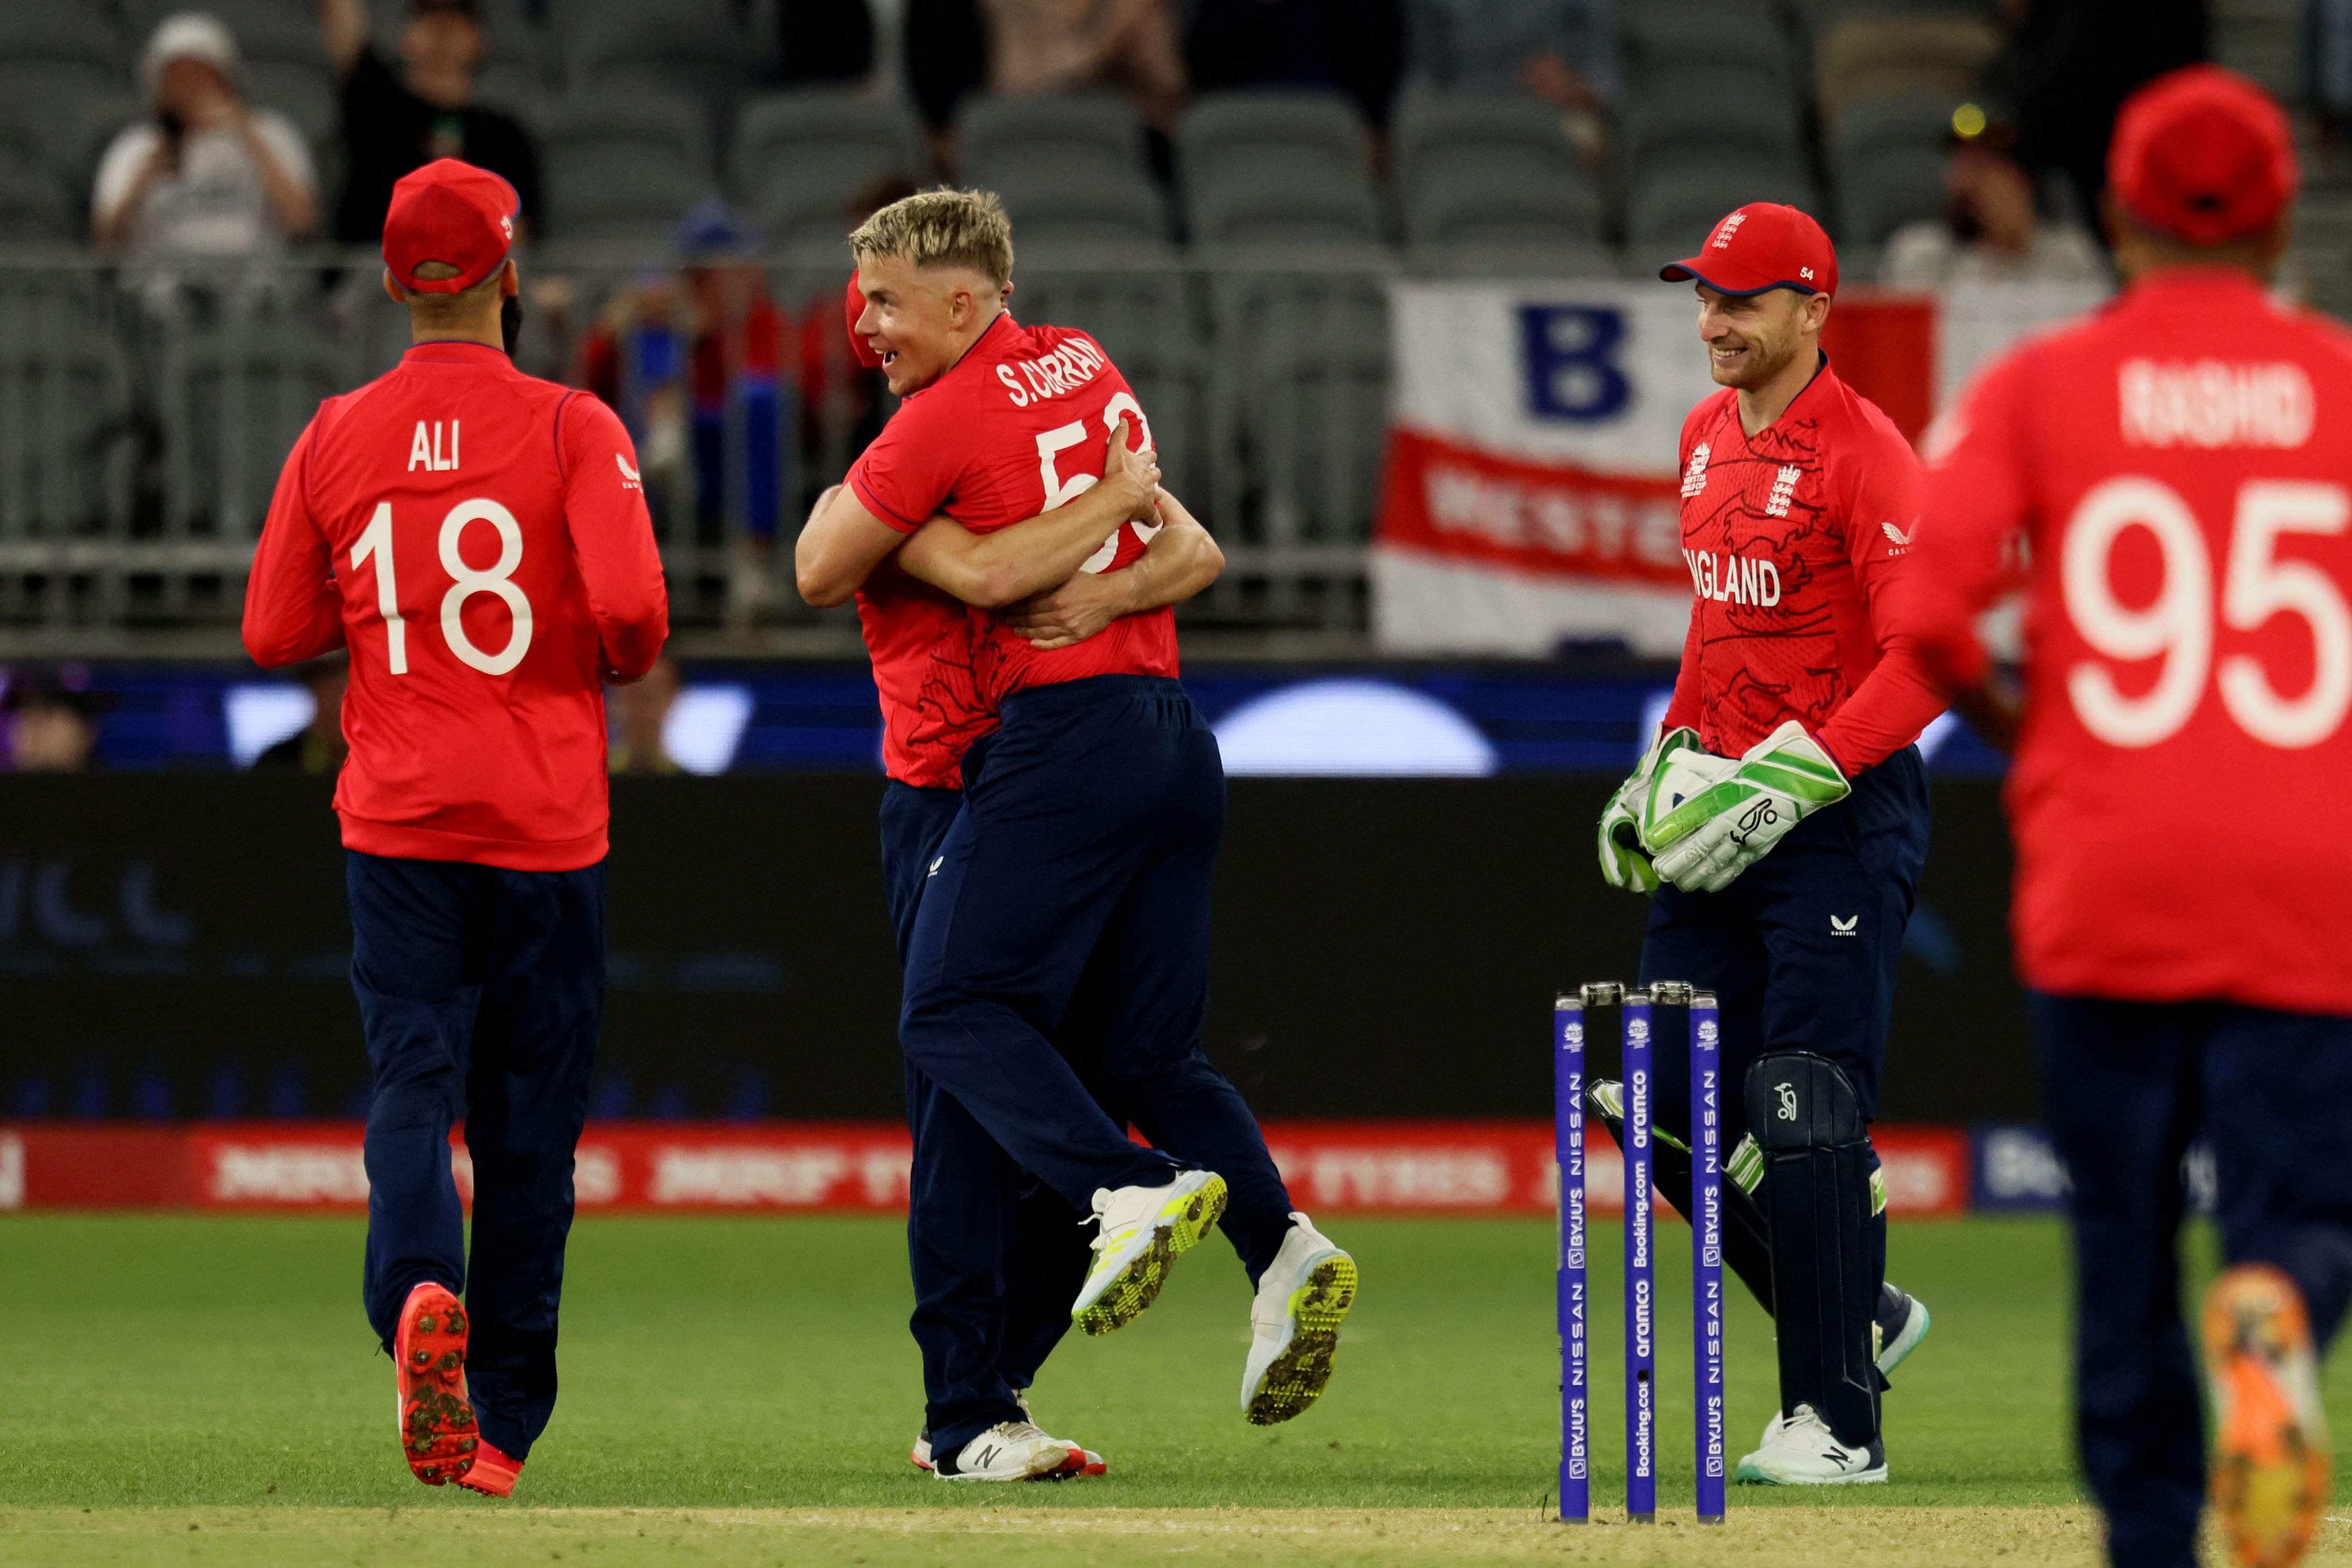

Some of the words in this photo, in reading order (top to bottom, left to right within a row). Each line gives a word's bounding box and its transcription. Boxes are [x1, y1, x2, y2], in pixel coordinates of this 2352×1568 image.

[1799, 266, 1814, 281] 54
[996, 337, 1105, 408] S.CURRAN
[1519, 303, 1630, 421] B
[407, 419, 460, 472] ALI
[350, 498, 533, 676] 18
[1682, 547, 1781, 607] NGLAND
[2061, 475, 2352, 749] 95
[1569, 1072, 1582, 1176] NISSAN
[1632, 1069, 1647, 1148] aramco
[1703, 1071, 1717, 1174] NISSAN
[1570, 1187, 1583, 1247] BYJU'S
[1633, 1161, 1649, 1267] Booking.com
[1704, 1185, 1718, 1245] BYJU'S
[1572, 1283, 1584, 1386] NISSAN
[1635, 1279, 1650, 1358] aramco
[1707, 1281, 1720, 1384] NISSAN
[1571, 1398, 1585, 1457] BYJU'S
[1708, 1395, 1722, 1455] BYJU'S
